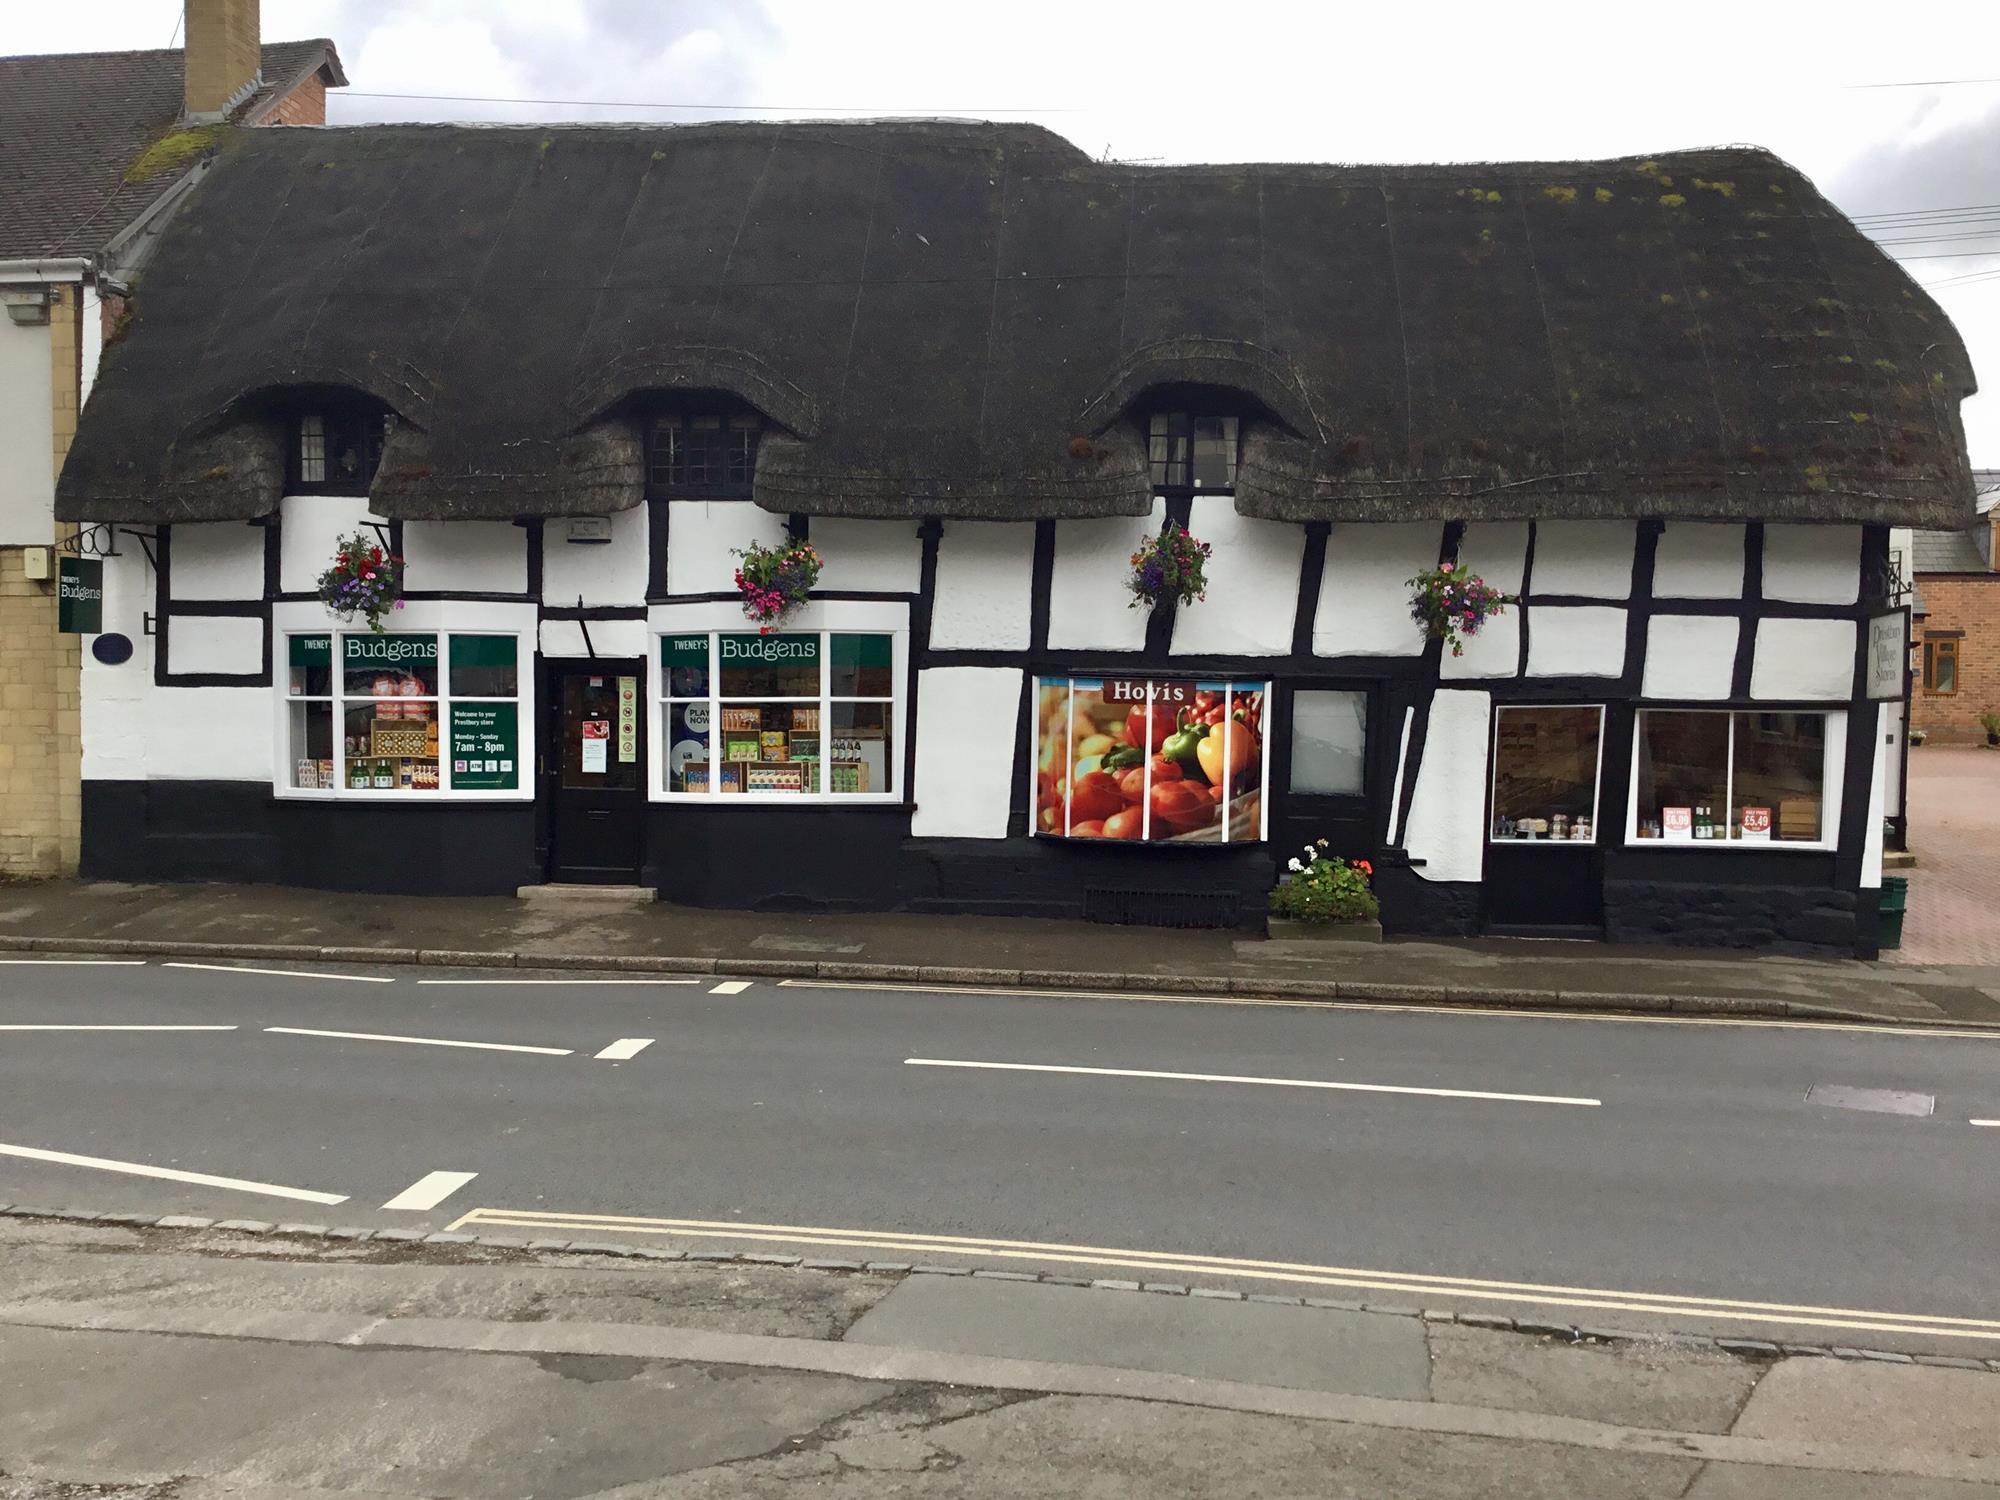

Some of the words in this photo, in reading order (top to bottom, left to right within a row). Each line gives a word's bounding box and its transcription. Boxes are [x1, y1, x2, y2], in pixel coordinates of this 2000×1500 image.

[61, 584, 101, 600] Budgens
[346, 639, 438, 661] Budgens
[674, 639, 709, 650] TWENEY'S
[721, 638, 816, 662] Budgens
[1113, 681, 1184, 701] Hovis
[689, 709, 710, 717] PLAY
[454, 719, 480, 727] Prestbury
[689, 716, 710, 724] NOW
[454, 733, 475, 741] Monday
[479, 733, 499, 741] Sunday
[455, 741, 475, 752] 7am
[484, 741, 505, 754] 8pm
[1744, 815, 1769, 827] £5.49
